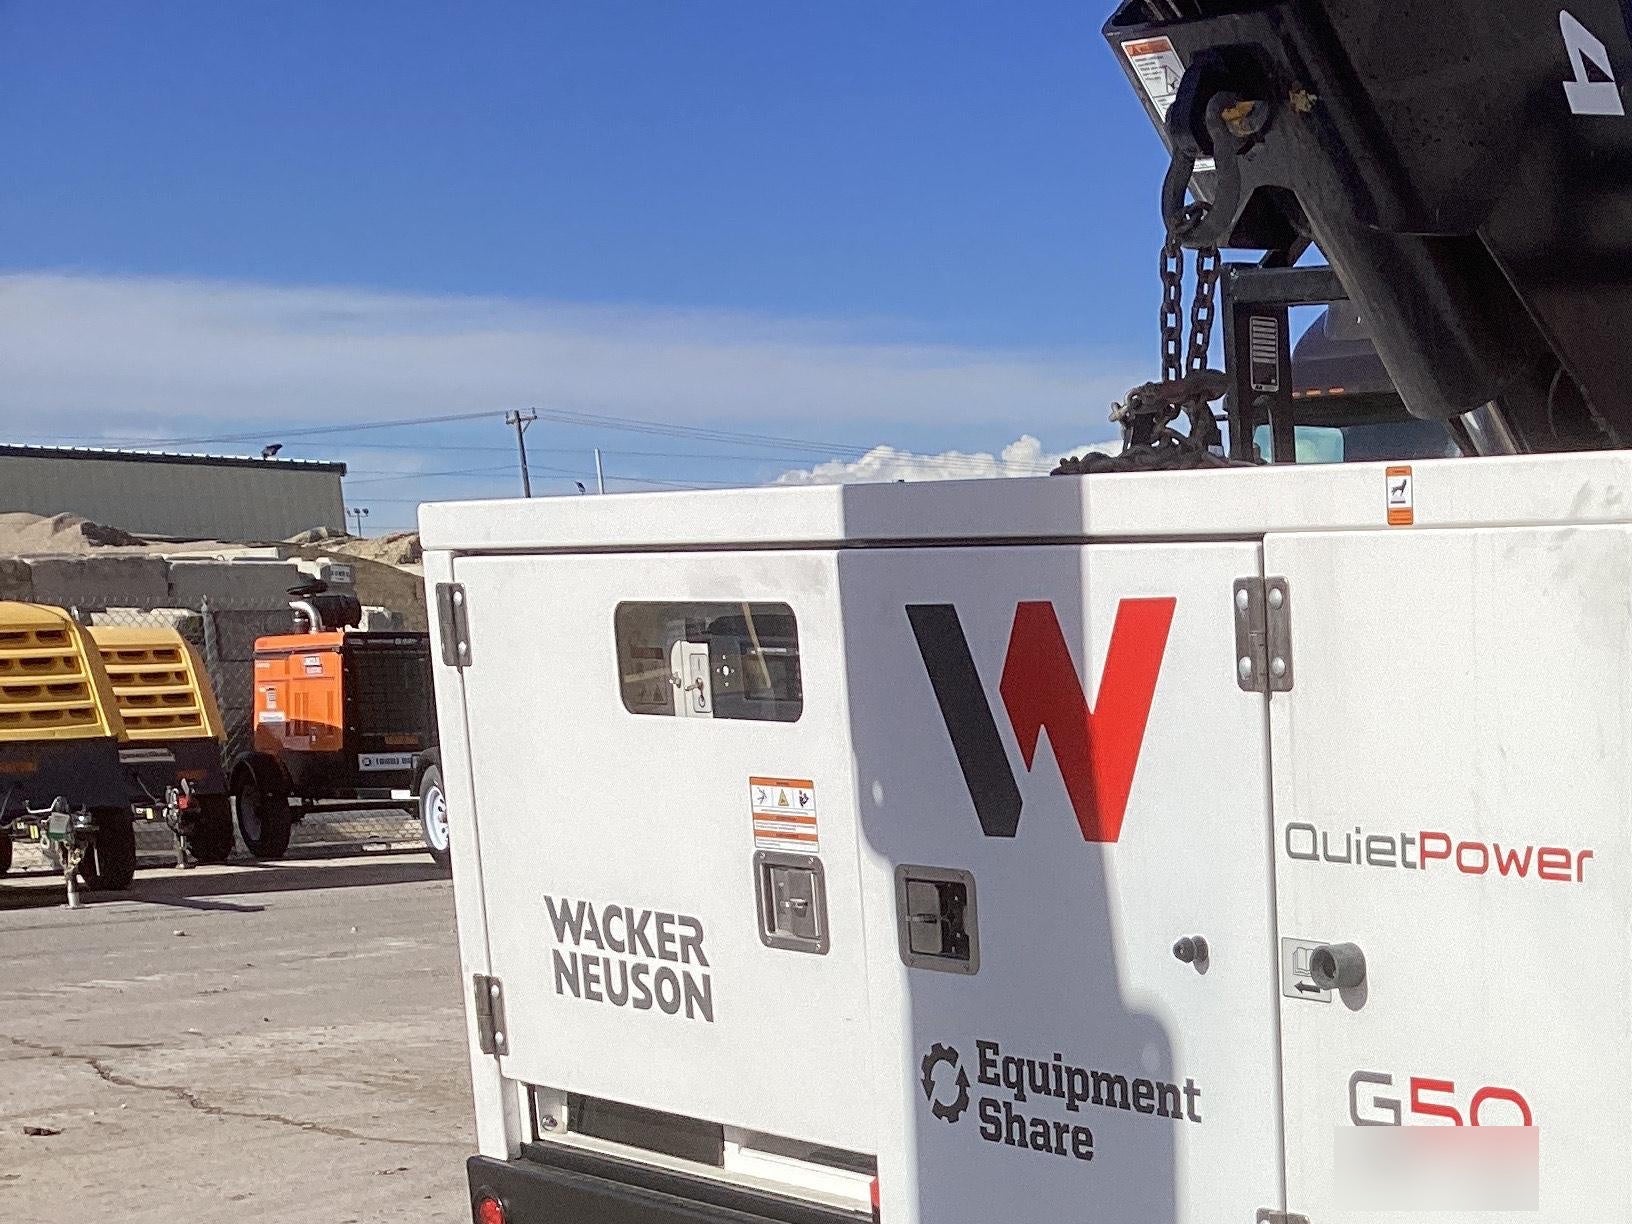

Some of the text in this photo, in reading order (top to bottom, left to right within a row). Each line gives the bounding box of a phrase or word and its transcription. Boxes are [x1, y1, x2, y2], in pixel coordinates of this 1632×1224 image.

[1285, 821, 1595, 883] QuietPower
[543, 894, 711, 968] WACKER
[552, 948, 715, 1024] NEUSON
[975, 1039, 1202, 1124] Equipment
[978, 1096, 1095, 1161] Share
